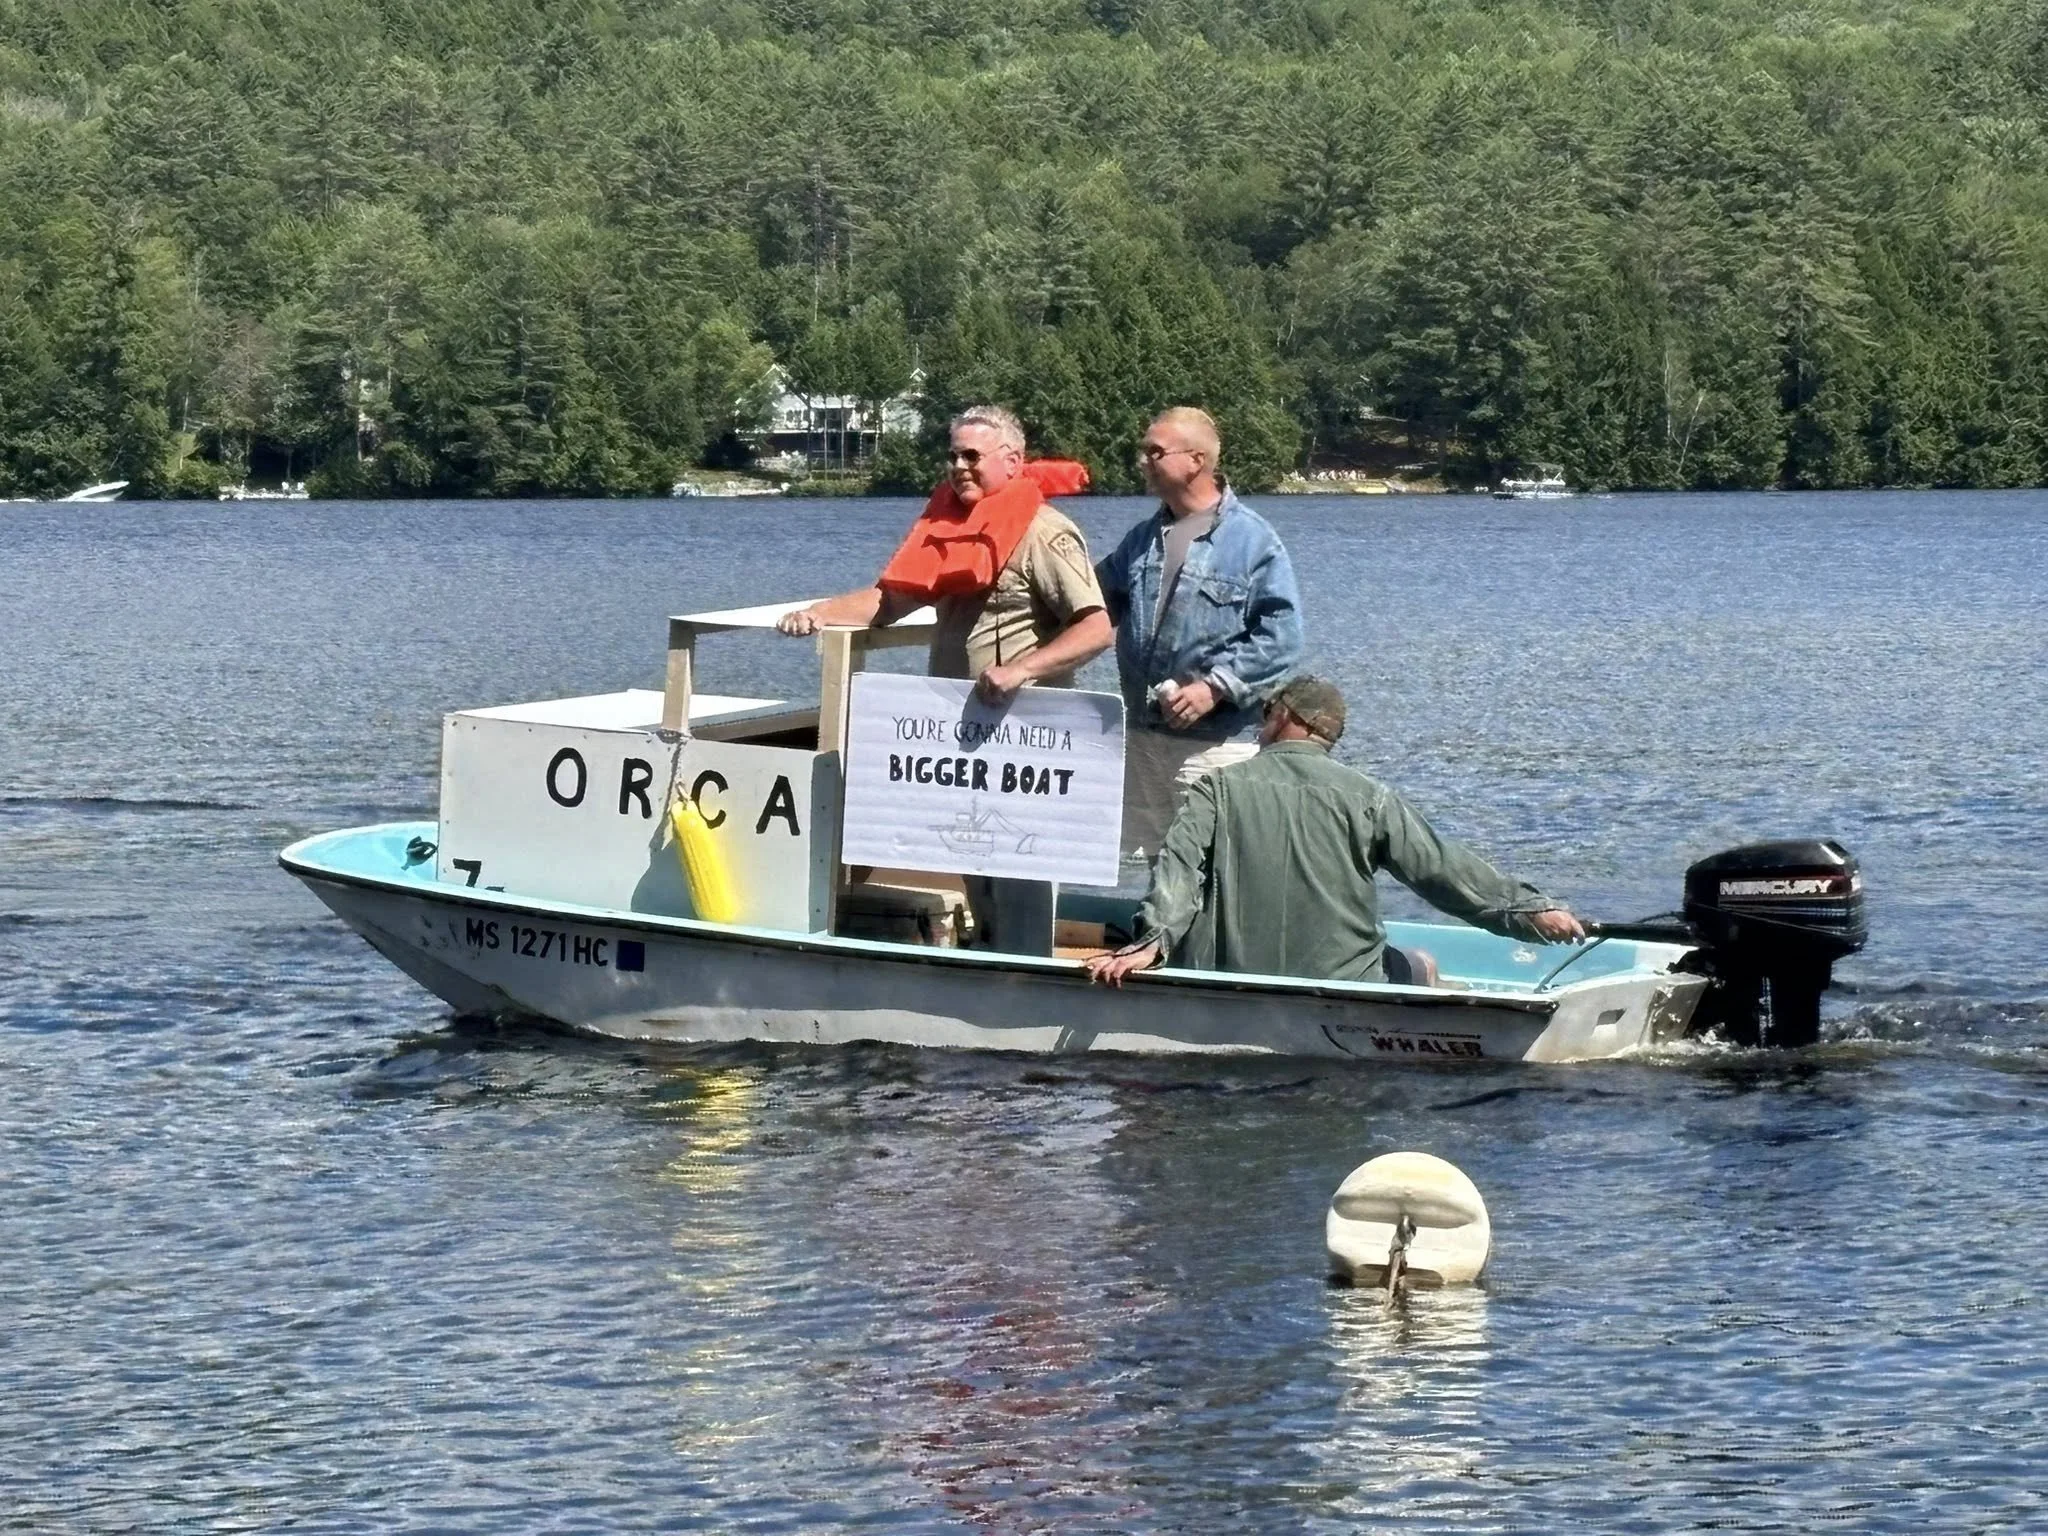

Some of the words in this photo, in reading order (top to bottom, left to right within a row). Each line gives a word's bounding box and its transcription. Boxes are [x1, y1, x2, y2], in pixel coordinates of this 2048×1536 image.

[954, 721, 1011, 744] GONNA
[1019, 726, 1056, 749] NEED
[1061, 729, 1072, 751] A
[546, 747, 801, 836] ORCA
[889, 753, 989, 791] BIGGER
[1001, 762, 1075, 795] BOAT
[1719, 880, 1832, 895] MERCURY
[466, 918, 500, 949] MS
[511, 926, 566, 962] 1271
[574, 935, 608, 967] HC
[1370, 1035, 1483, 1056] WHALER
